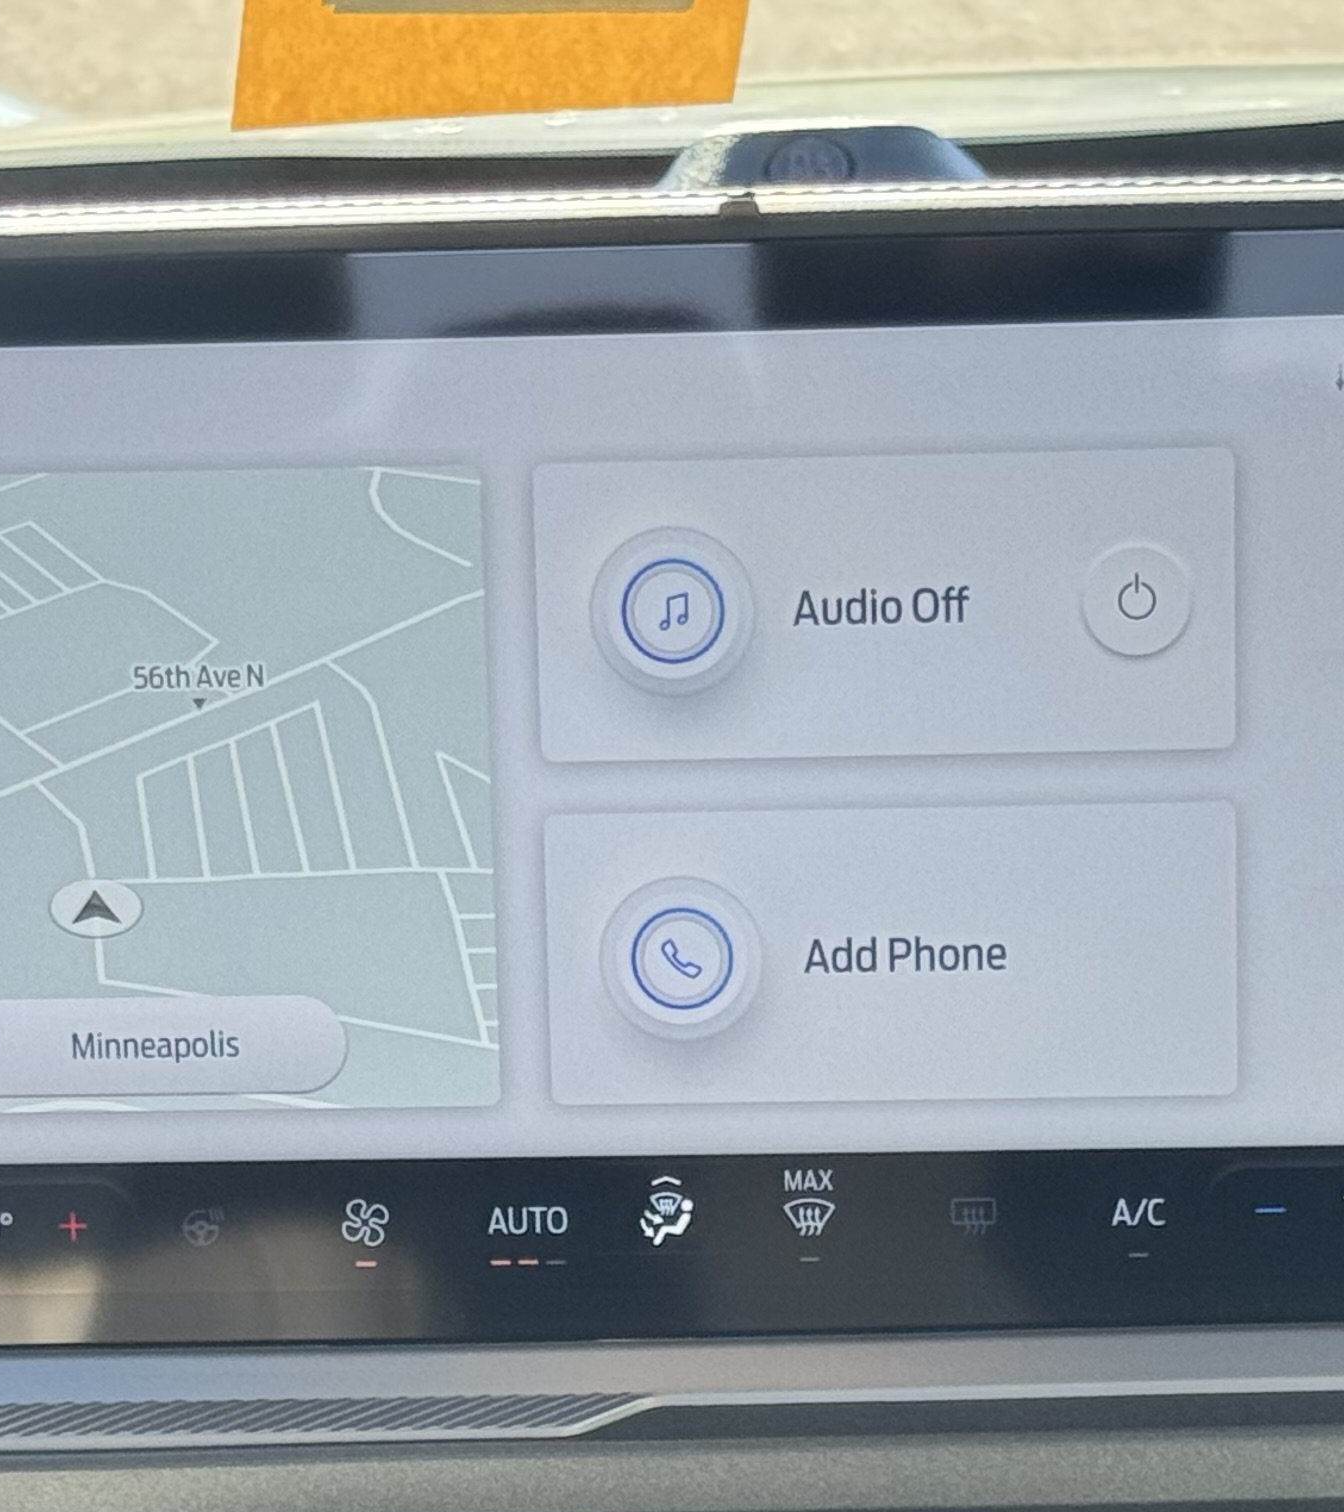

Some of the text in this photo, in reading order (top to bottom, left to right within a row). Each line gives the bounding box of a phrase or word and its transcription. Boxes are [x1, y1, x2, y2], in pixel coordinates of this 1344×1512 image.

[793, 585, 970, 627] Audio Off
[134, 664, 264, 690] 56th Ave N
[804, 935, 1007, 974] Add Phone
[71, 1029, 240, 1064] Minneapolis
[784, 1169, 834, 1192] MAX
[488, 1206, 568, 1235] AUTO
[1111, 1197, 1166, 1227] A/C
